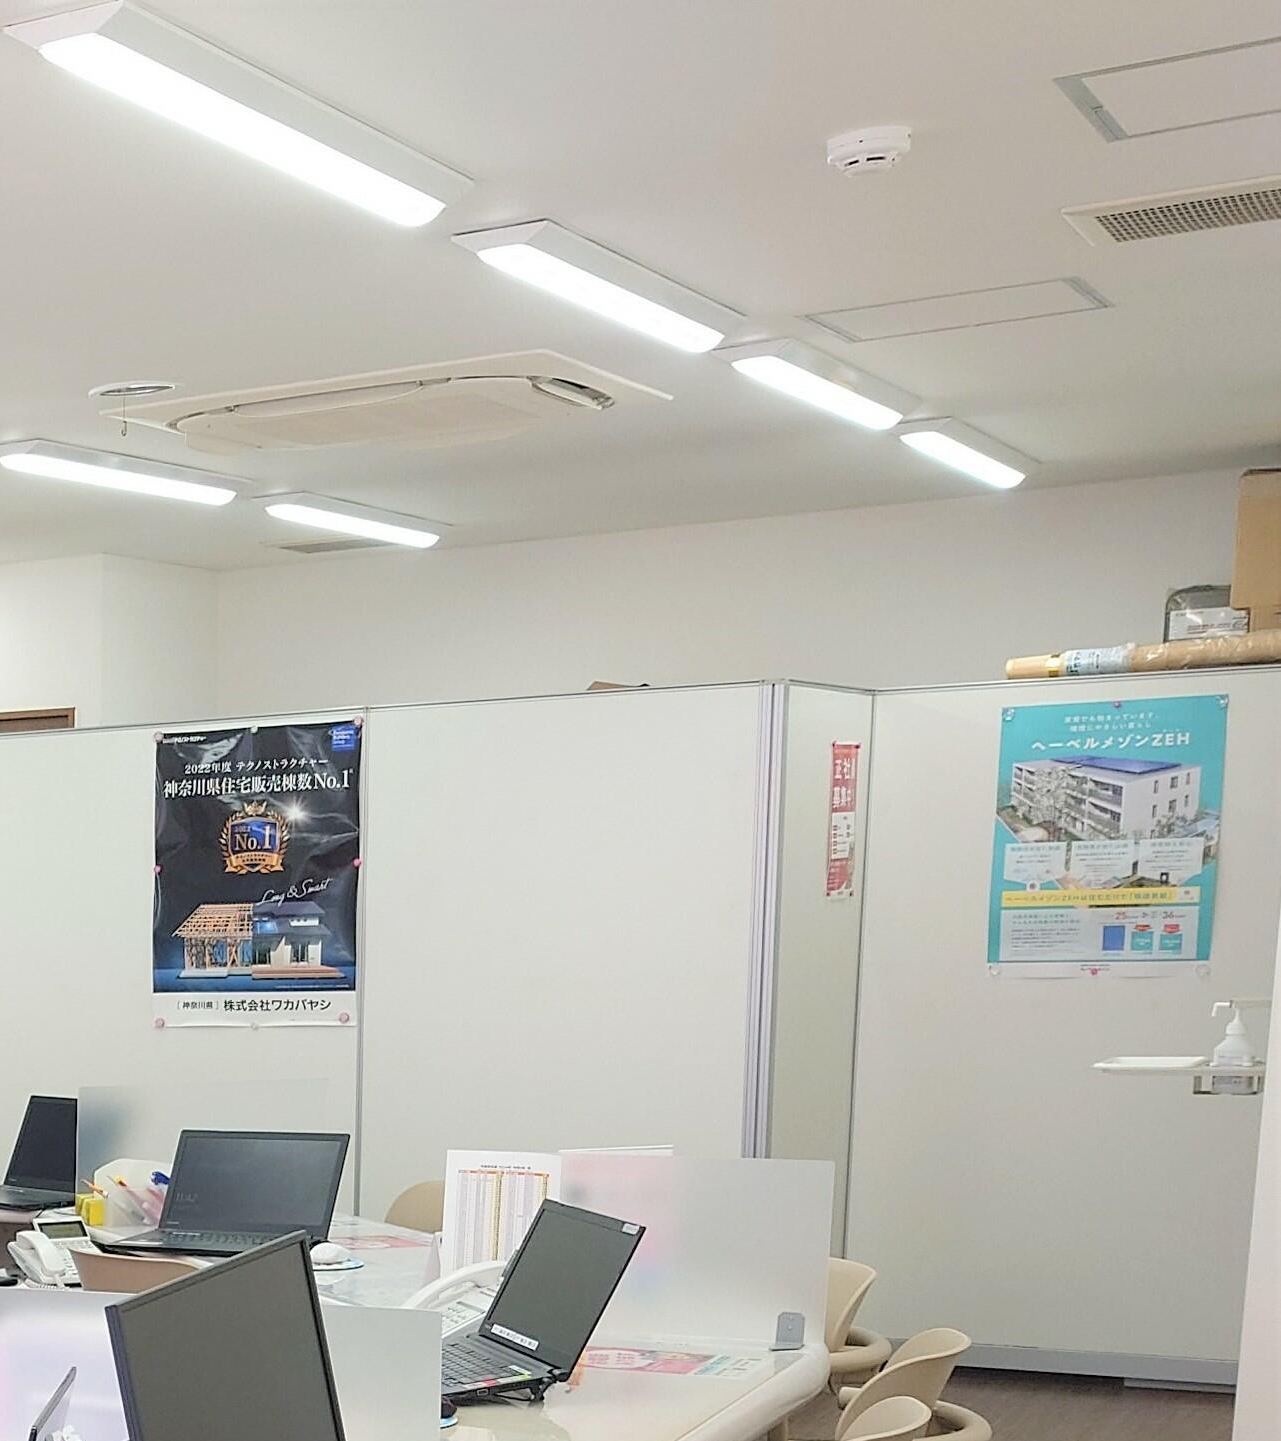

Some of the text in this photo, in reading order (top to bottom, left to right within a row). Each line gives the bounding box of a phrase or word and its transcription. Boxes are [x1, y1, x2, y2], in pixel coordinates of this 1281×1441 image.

[1031, 732, 1190, 751] ヘーベルメゾンZEH
[184, 758, 328, 774] 2022年度 テクノストラクチャー
[234, 824, 272, 851] No.1
[287, 885, 298, 898] &
[223, 999, 332, 1012] 株式会社ワカバヤシ
